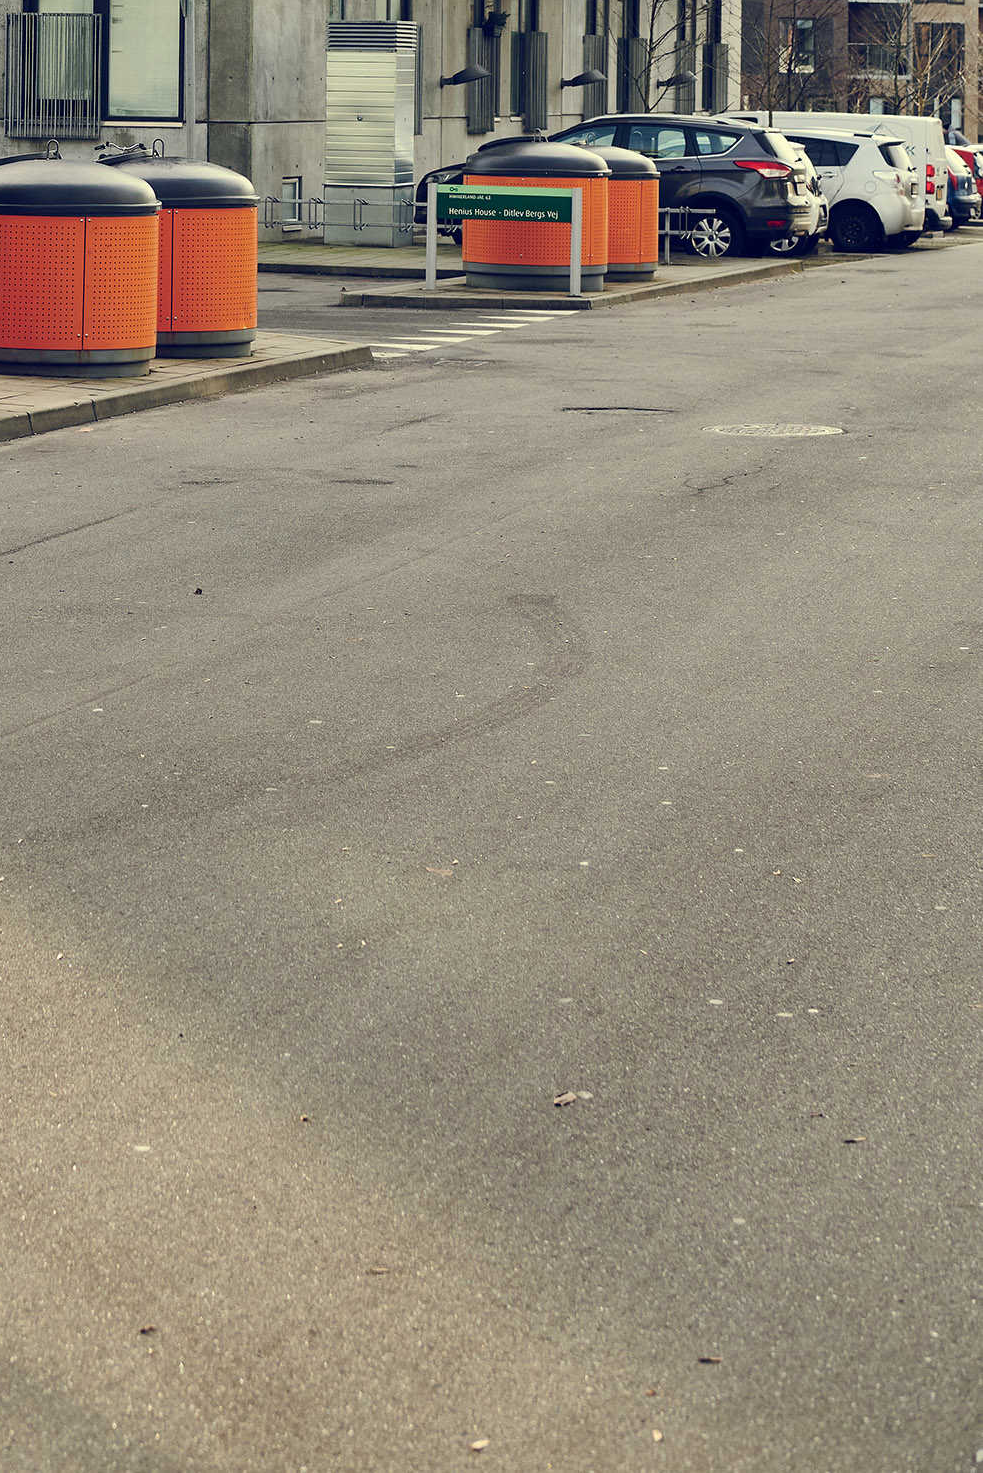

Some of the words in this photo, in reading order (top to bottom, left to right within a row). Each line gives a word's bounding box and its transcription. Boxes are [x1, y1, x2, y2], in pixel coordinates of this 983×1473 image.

[449, 207, 472, 216] Henius
[474, 208, 497, 217] House
[503, 208, 524, 218] Ditlev
[525, 209, 546, 220] Bergs
[546, 209, 559, 220] Vej
